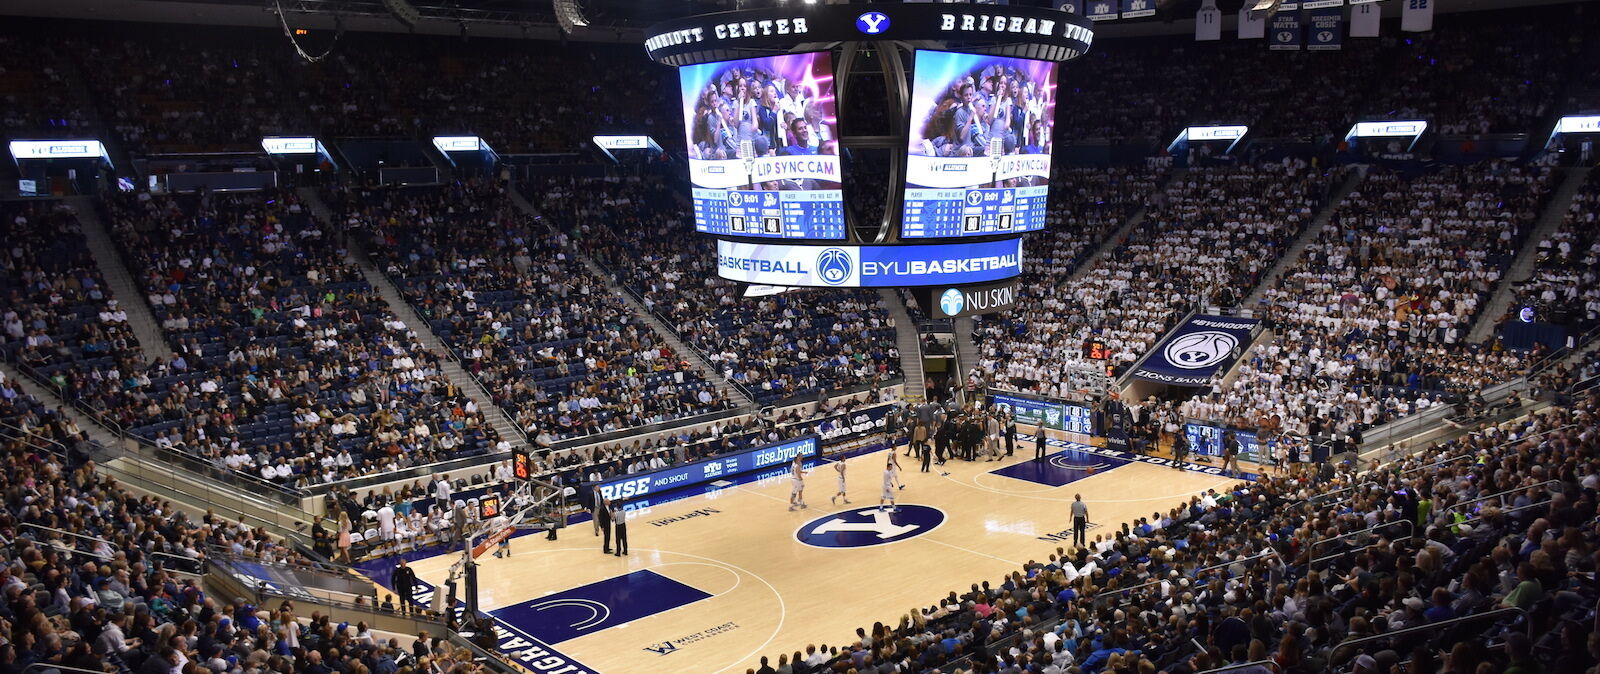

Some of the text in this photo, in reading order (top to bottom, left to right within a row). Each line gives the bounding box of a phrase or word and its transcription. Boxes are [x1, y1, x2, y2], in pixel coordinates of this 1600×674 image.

[860, 13, 885, 34] Y
[941, 14, 1055, 36] BRIGHAM
[1203, 13, 1213, 24] 11
[714, 17, 808, 39] CENTER
[758, 161, 835, 177] LIP SYNC CAM
[1002, 160, 1048, 174] LIP SYNC CAM
[743, 194, 758, 203] 5:01
[984, 192, 999, 201] 5:01
[719, 254, 808, 274] BASKETBALL
[966, 286, 1014, 311] NU SKIN
[1192, 319, 1255, 331] #BYUHOOPS
[1135, 369, 1209, 385] ZIONS BANK
[1108, 437, 1127, 446] vivint.
[755, 441, 814, 467] rise.byu.edu
[703, 462, 722, 473] BYU
[600, 477, 650, 501] RISE
[654, 473, 688, 487] AND SHOUT
[811, 509, 920, 539] Y
[673, 621, 735, 644] WEST COAST
[681, 625, 741, 646] CONFERENCE
